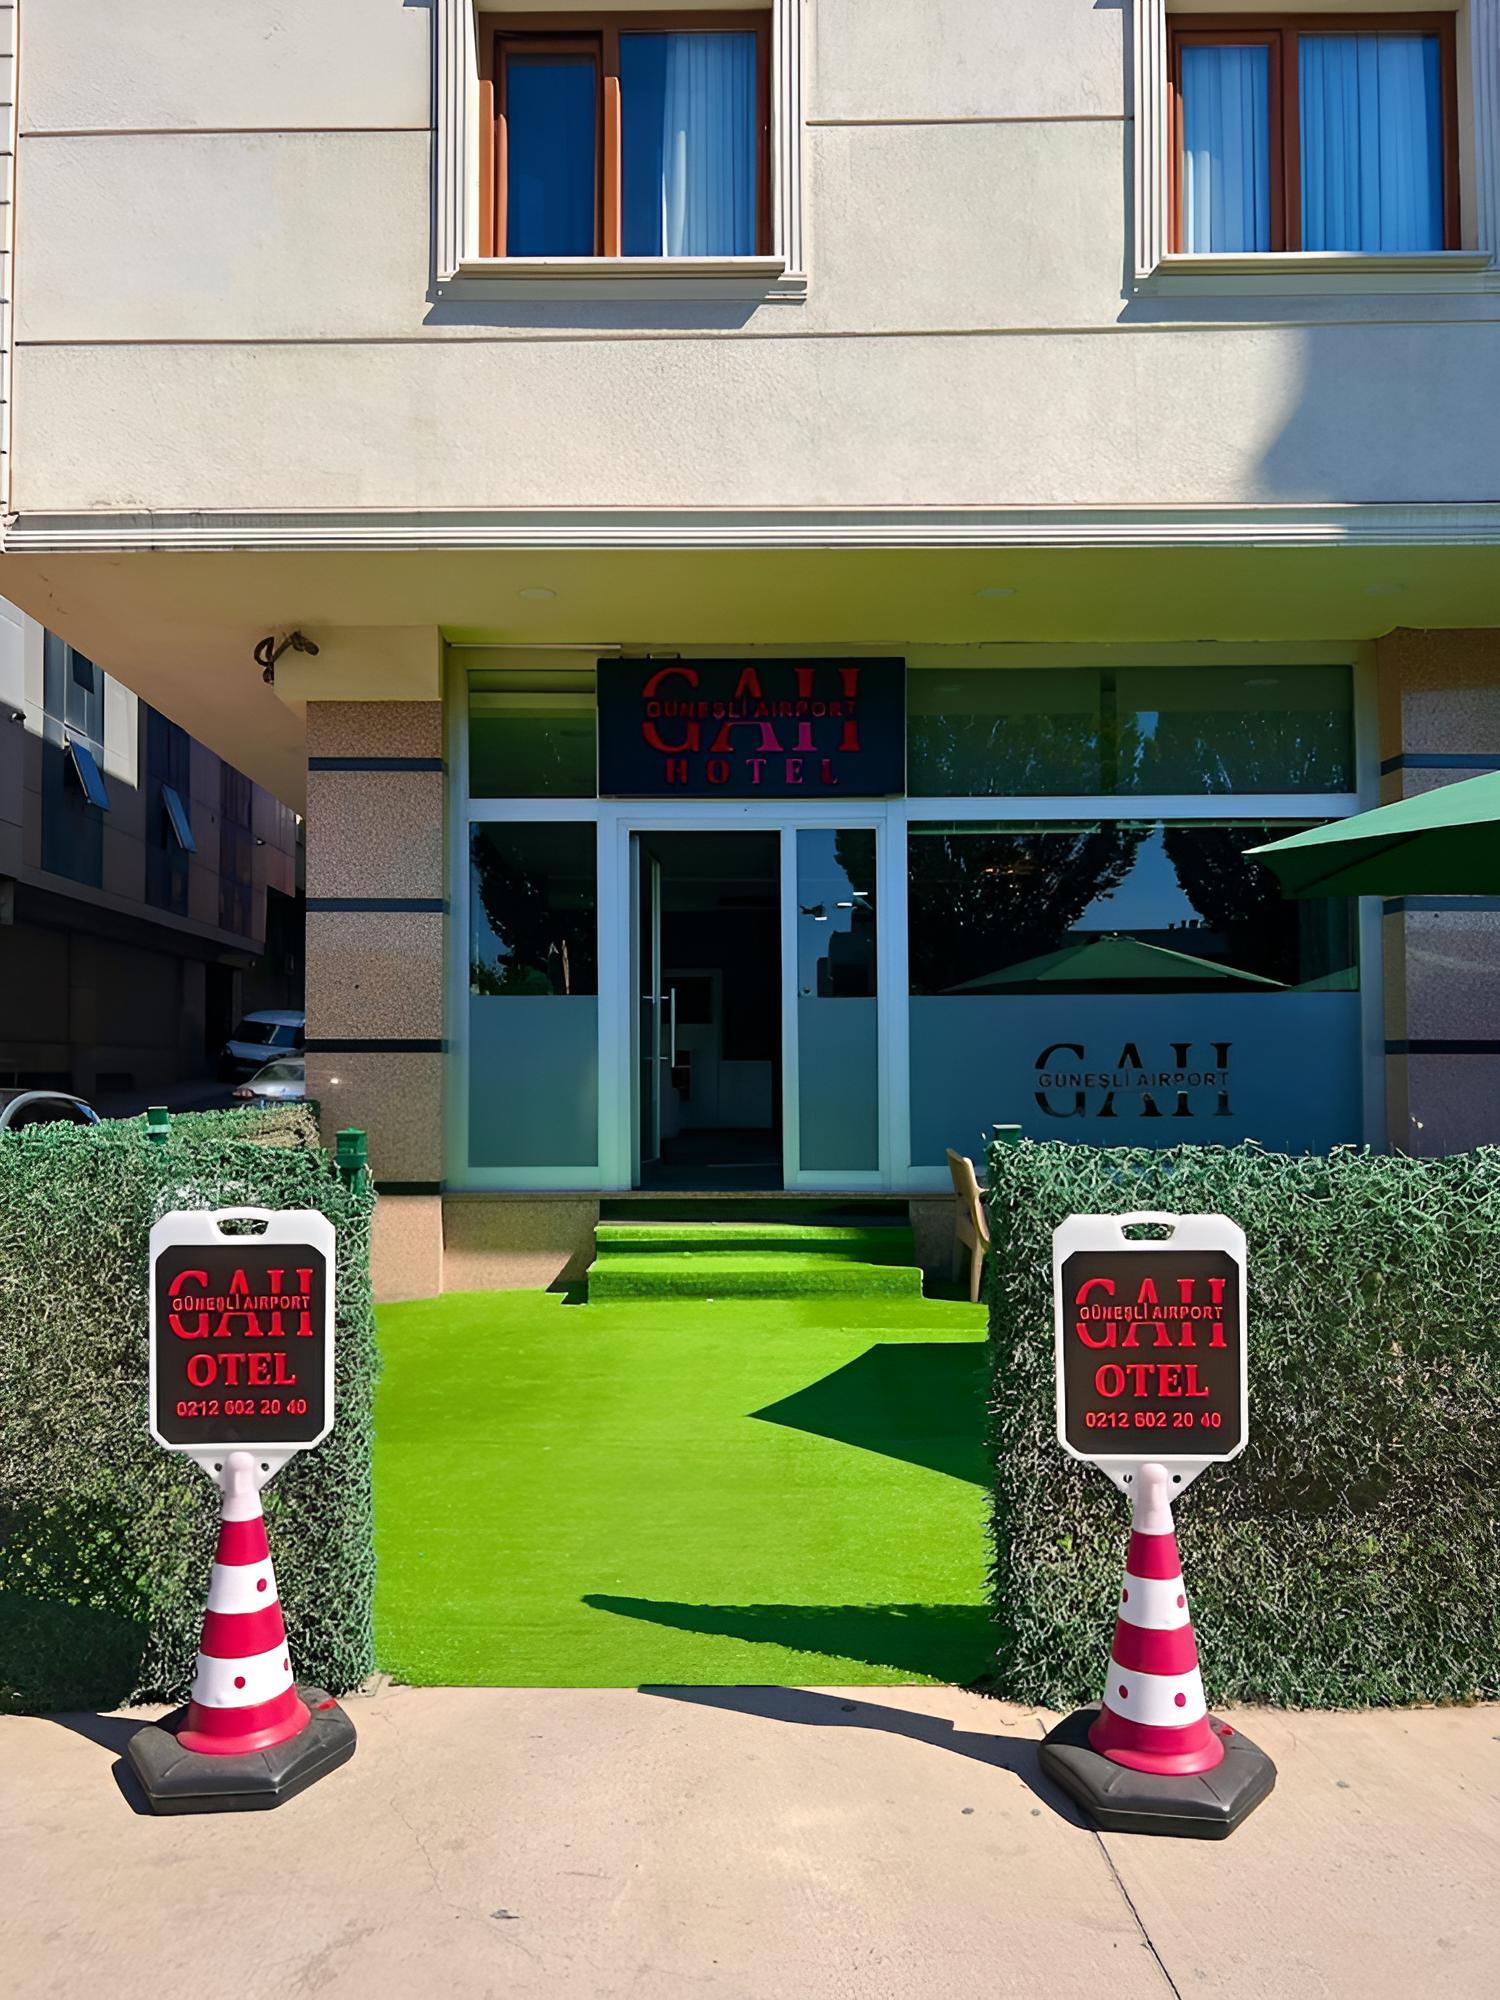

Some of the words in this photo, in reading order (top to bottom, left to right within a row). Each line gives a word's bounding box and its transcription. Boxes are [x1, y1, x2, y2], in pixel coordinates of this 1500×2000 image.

[641, 666, 861, 753] GAH
[753, 699, 858, 718] AIRPORT
[665, 758, 840, 785] HOTEL
[1136, 1071, 1229, 1087] AIRPORT
[167, 1268, 315, 1340] GAH
[243, 1295, 311, 1311] AIRPORT
[1075, 1278, 1228, 1349] GAH
[1152, 1305, 1224, 1320] AIRPORT
[186, 1352, 297, 1388] OTEL
[1094, 1363, 1210, 1398] OTEL
[176, 1400, 220, 1417] 0212
[224, 1400, 256, 1416] 602
[260, 1399, 281, 1416] 20
[286, 1399, 308, 1415] 40
[1085, 1412, 1130, 1428] 0212
[1134, 1412, 1168, 1428] 602
[1173, 1412, 1194, 1428] 20
[1200, 1412, 1222, 1428] 40
